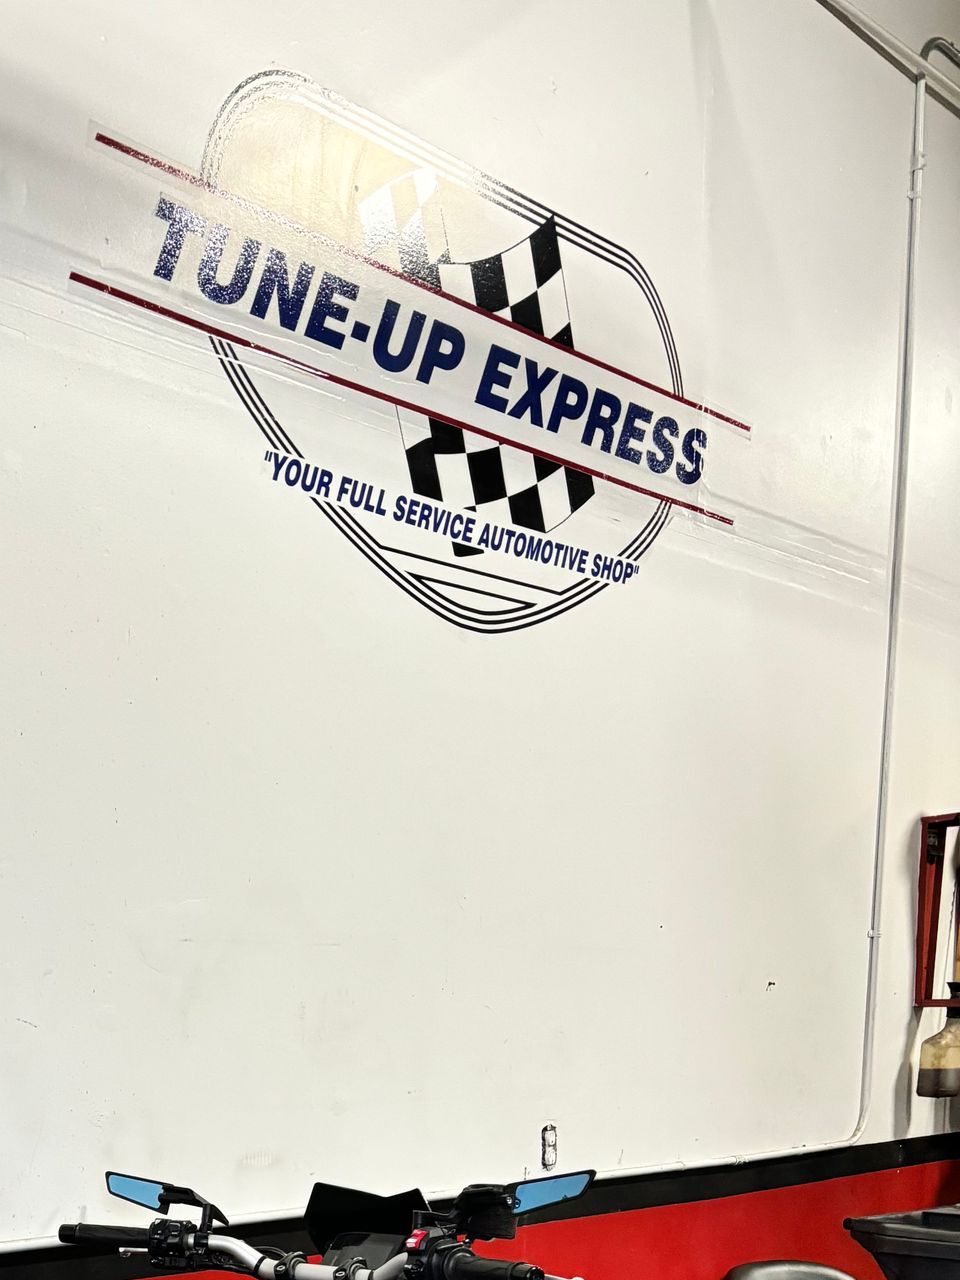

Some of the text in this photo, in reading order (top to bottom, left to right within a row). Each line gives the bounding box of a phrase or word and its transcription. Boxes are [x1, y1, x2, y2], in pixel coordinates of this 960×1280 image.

[153, 196, 708, 485] TUNE-UP EXPRESS
[263, 450, 640, 585] "YOUR FULL SERVICE AUTOMOTIVE SHOP"
